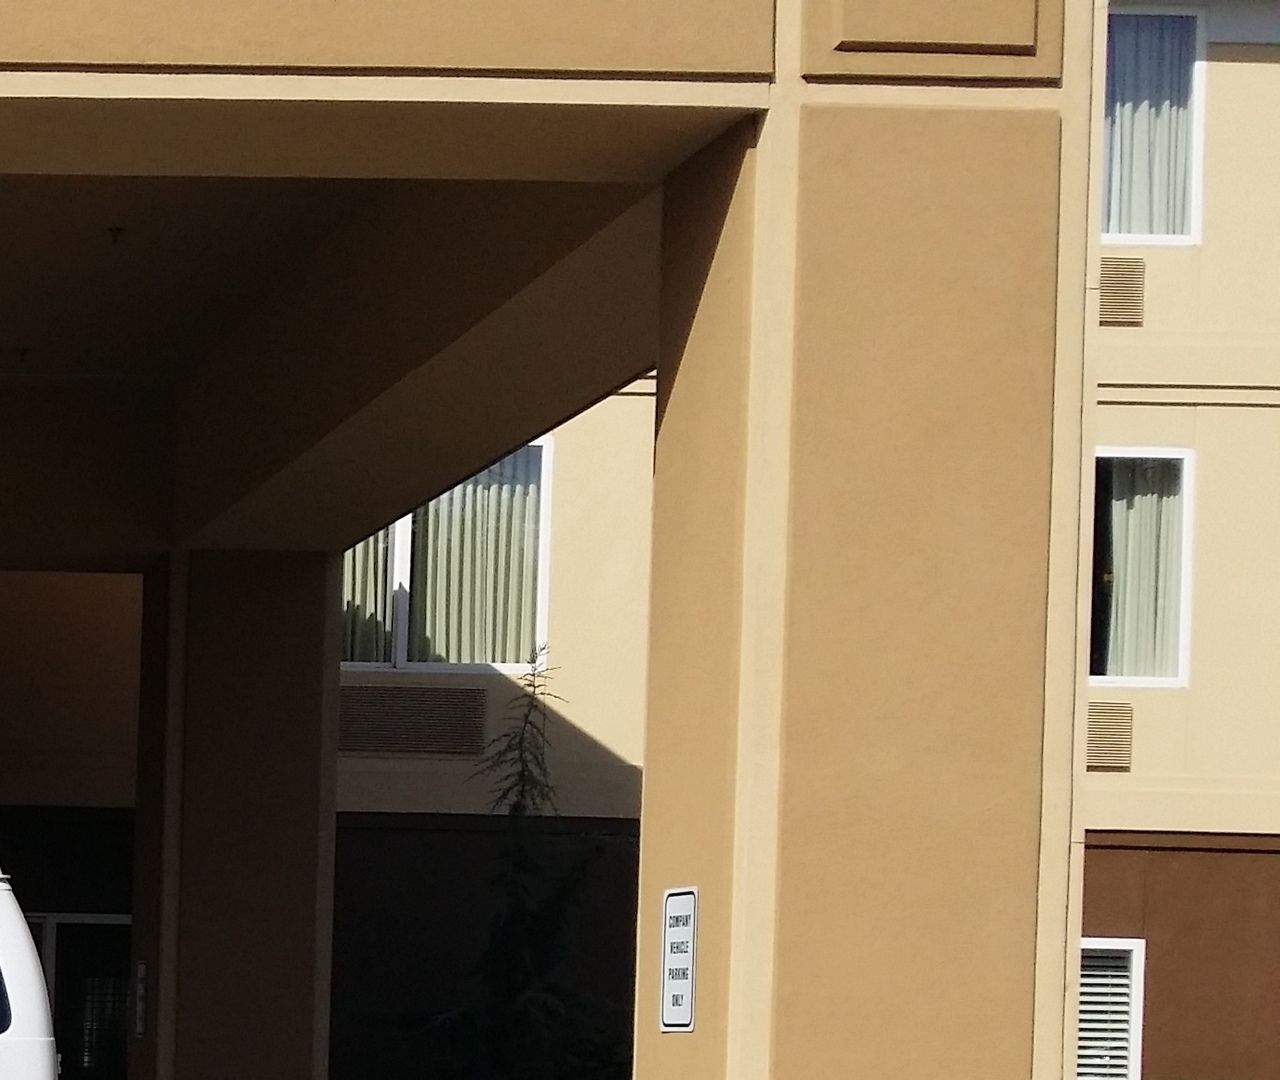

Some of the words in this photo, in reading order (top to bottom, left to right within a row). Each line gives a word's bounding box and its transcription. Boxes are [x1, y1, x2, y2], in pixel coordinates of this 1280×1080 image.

[668, 914, 691, 928] COMPANY
[670, 940, 689, 954] VEHICLE
[668, 967, 689, 981] PARKING
[672, 993, 684, 1007] ONLY
